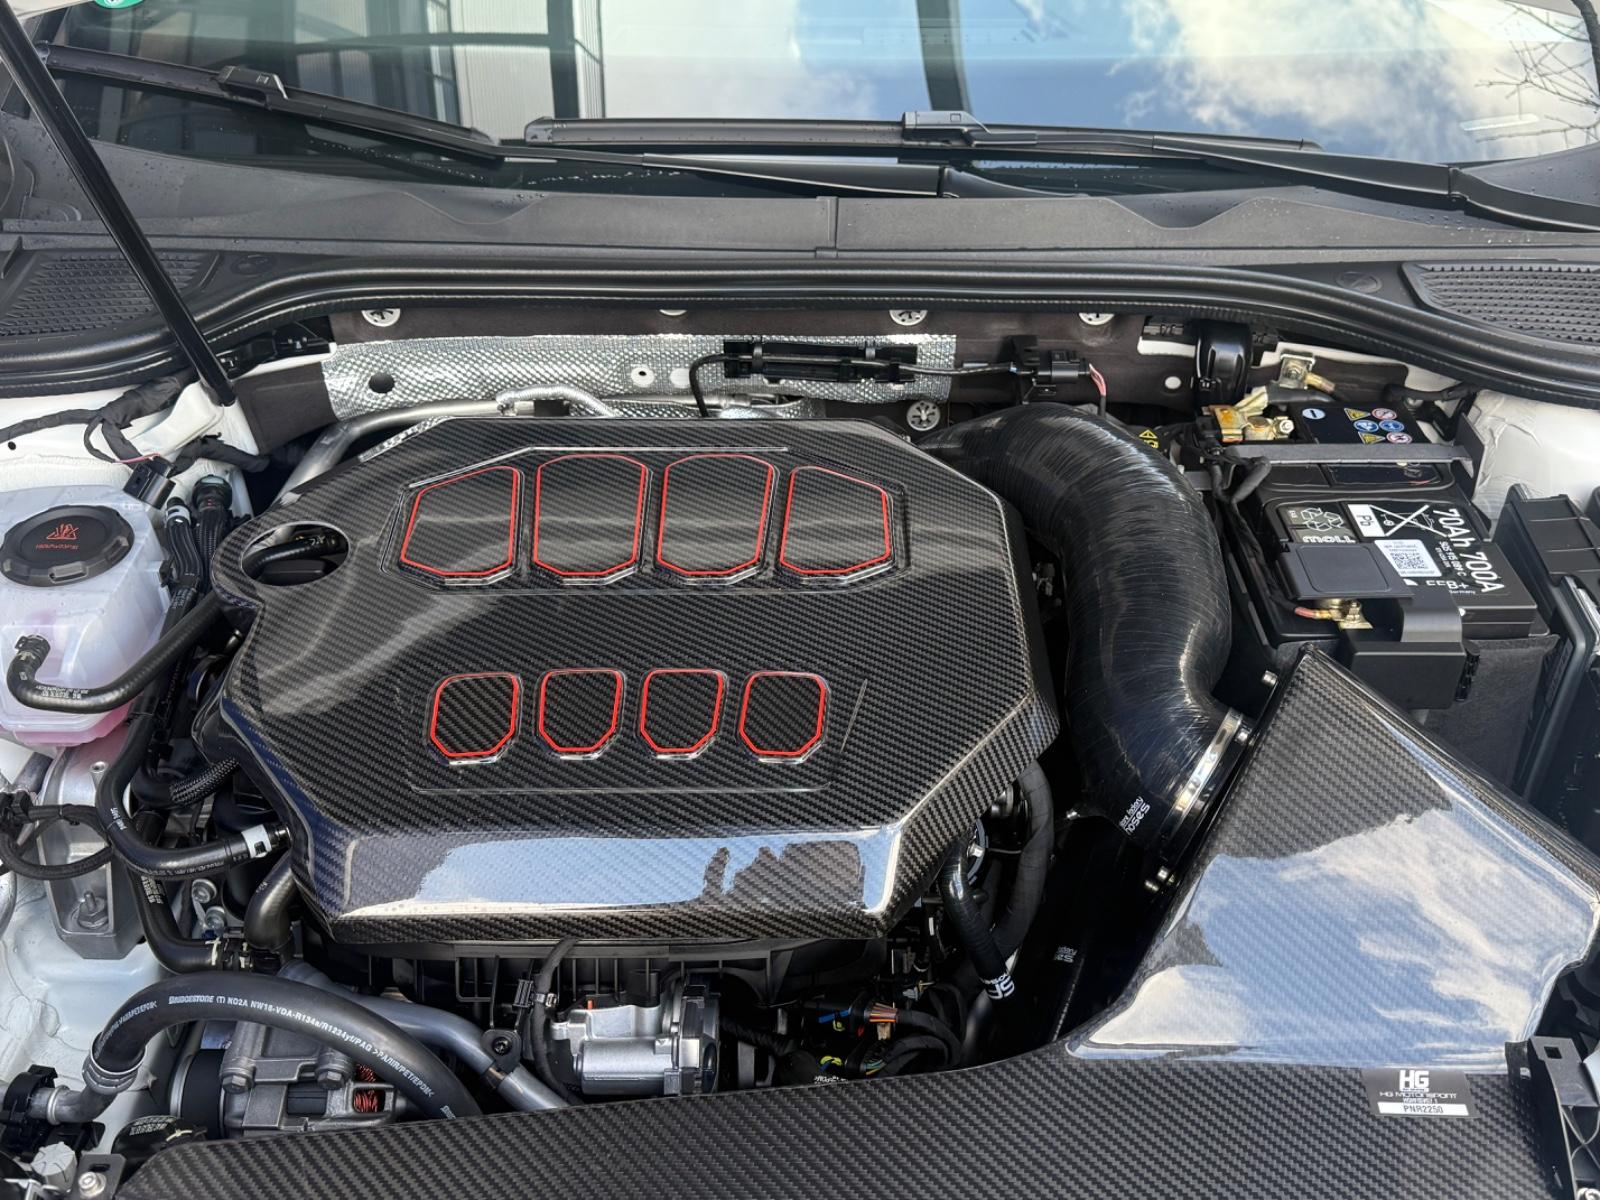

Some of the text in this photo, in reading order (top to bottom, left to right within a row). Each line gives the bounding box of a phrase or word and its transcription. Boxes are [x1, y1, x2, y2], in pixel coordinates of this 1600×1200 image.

[1433, 508, 1505, 593] 70Ah 700A
[1399, 1069, 1429, 1089] HG
